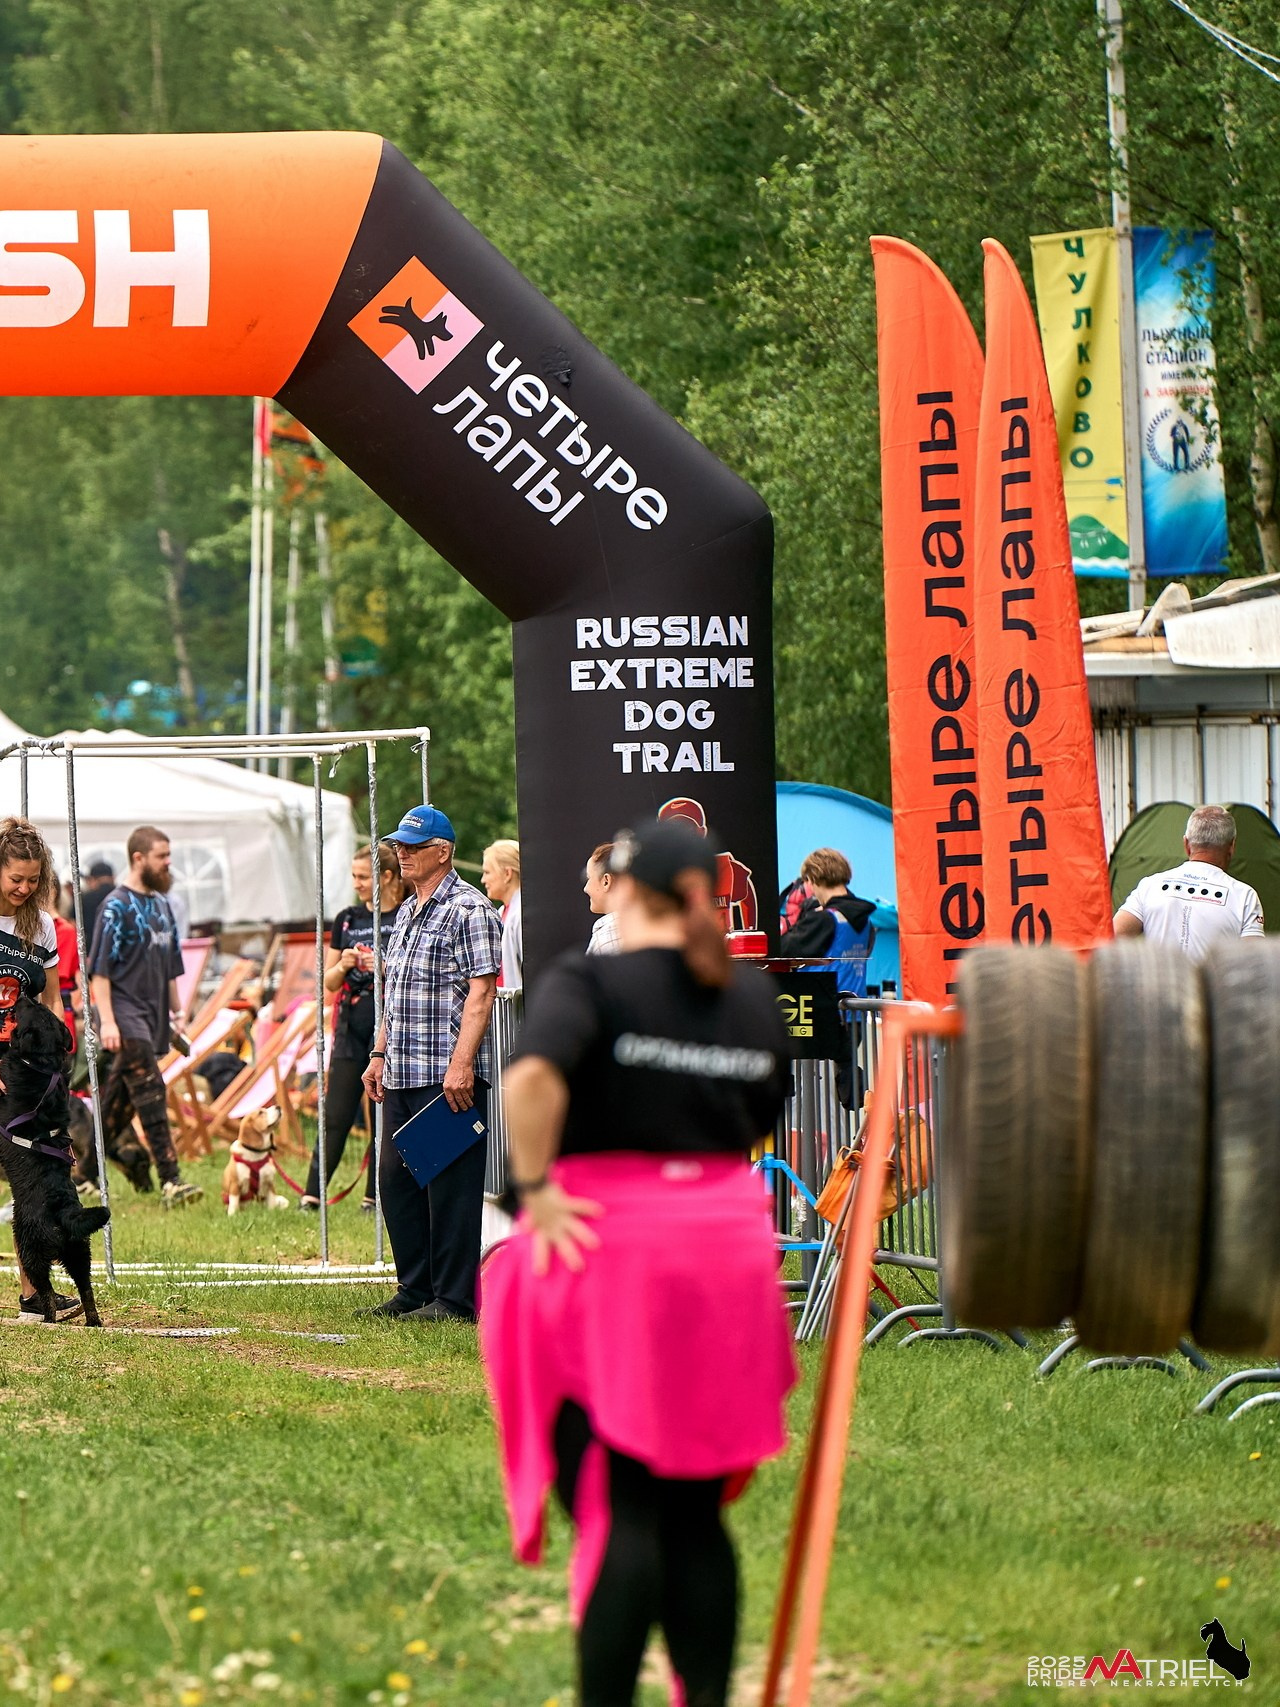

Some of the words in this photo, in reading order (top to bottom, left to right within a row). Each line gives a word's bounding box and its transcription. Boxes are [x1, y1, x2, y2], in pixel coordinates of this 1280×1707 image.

[1063, 236, 1095, 469] ЧУЛКОВО
[432, 385, 585, 527] лапы
[484, 340, 669, 531] четыре
[917, 391, 968, 629] лапы
[1001, 396, 1038, 641] лапы
[570, 657, 755, 691] EXTREME
[576, 615, 749, 649] RUSSIAN
[612, 741, 735, 774] TRAIL
[624, 699, 716, 732] DOG
[1004, 668, 1053, 950] етыре
[776, 994, 813, 1025] GE
